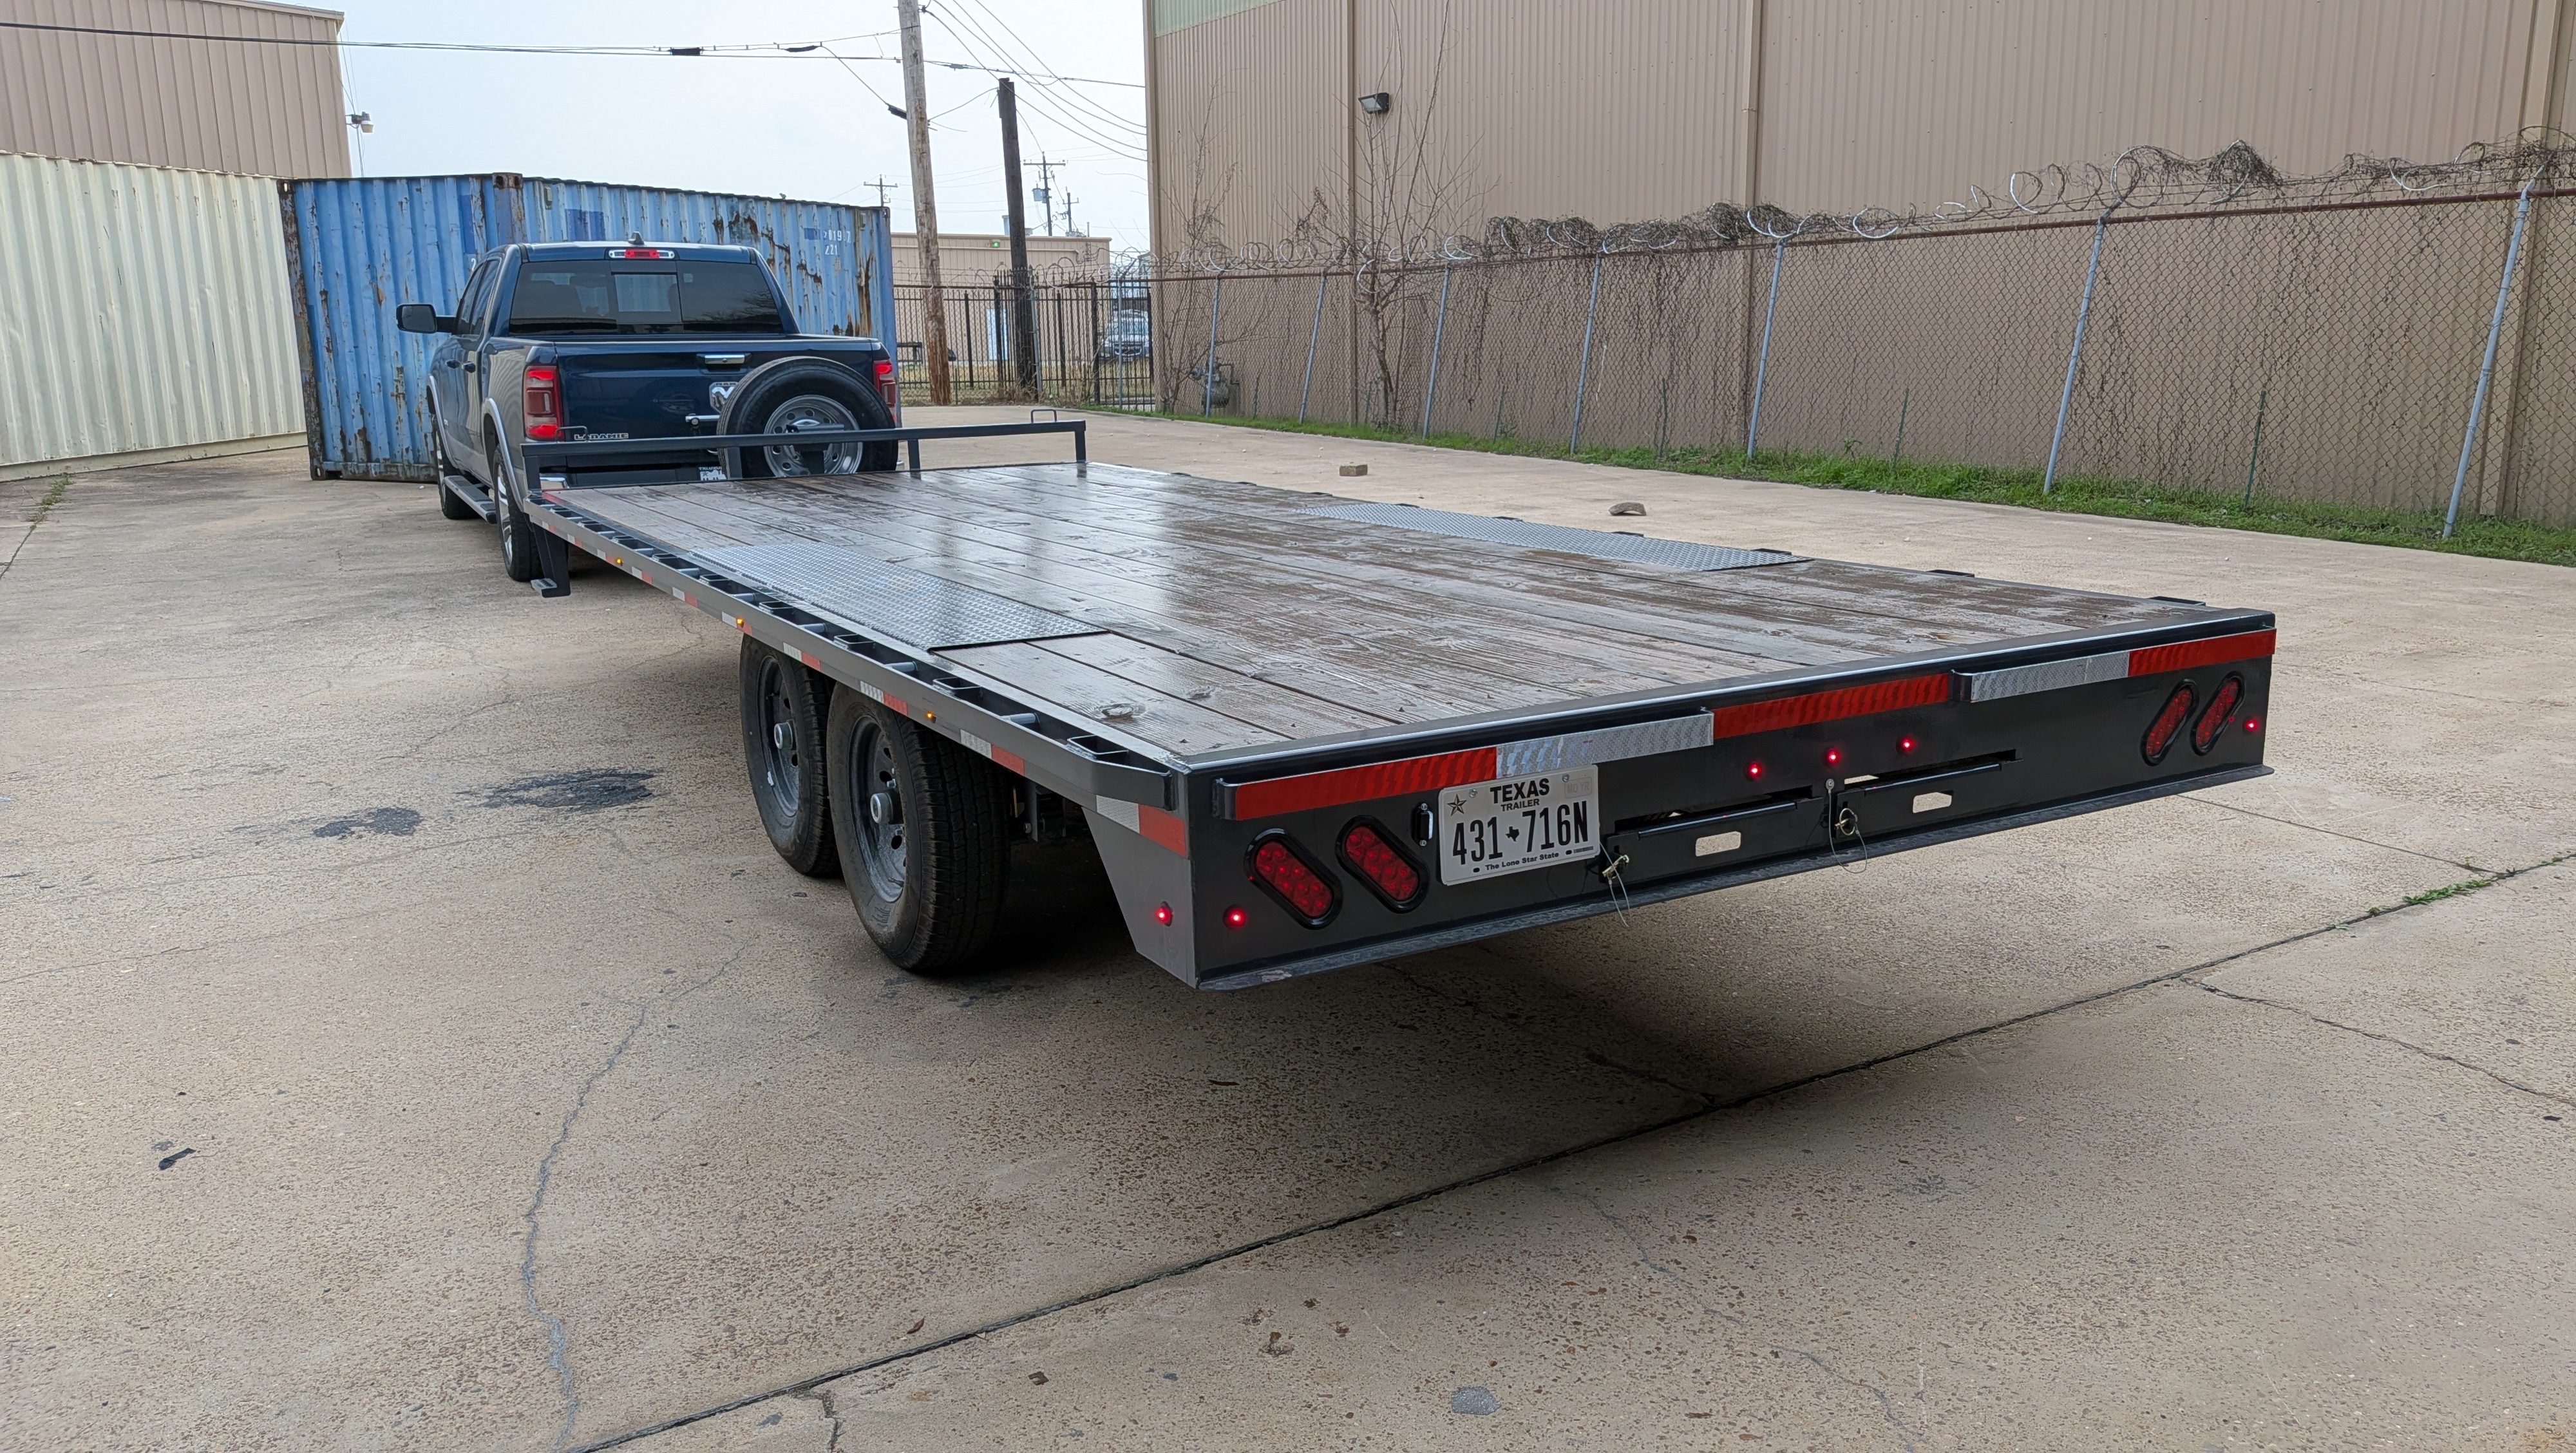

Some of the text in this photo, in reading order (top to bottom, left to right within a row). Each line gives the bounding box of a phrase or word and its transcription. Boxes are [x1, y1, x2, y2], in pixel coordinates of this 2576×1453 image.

[1490, 777, 1550, 804] TEXAS
[1567, 781, 1590, 794] MO YR
[1501, 798, 1540, 812] TRAILER
[1452, 800, 1589, 866] 431 716N
[1539, 852, 1559, 860] State
